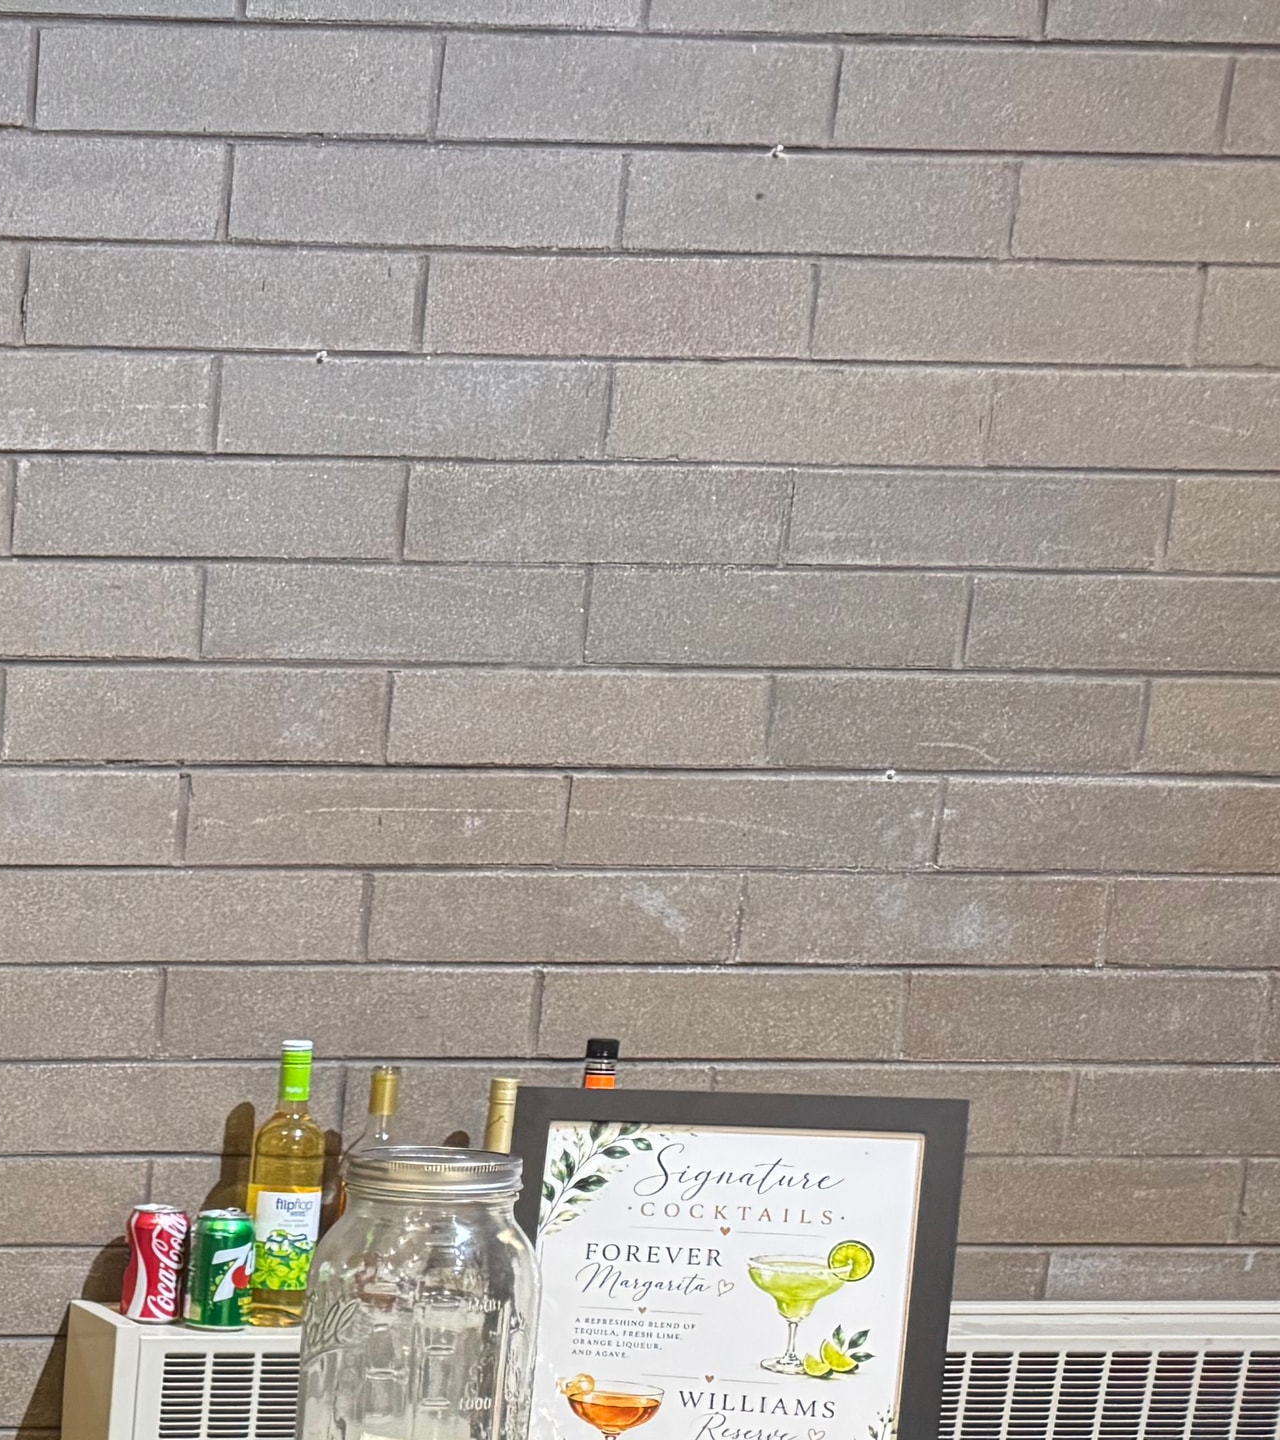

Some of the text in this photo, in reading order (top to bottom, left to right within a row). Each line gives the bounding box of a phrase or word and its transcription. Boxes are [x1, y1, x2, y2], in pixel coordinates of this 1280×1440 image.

[633, 1142, 847, 1203] Signature
[640, 1202, 834, 1226] COCKTAILS
[585, 1242, 723, 1267] FOREVER
[575, 1262, 711, 1302] Margarita
[584, 1317, 645, 1327] REFRESHING
[648, 1321, 680, 1329] BLEND
[623, 1330, 653, 1338] FRESH
[572, 1338, 612, 1347] ORANGE
[679, 1390, 837, 1419] WILLIAMS
